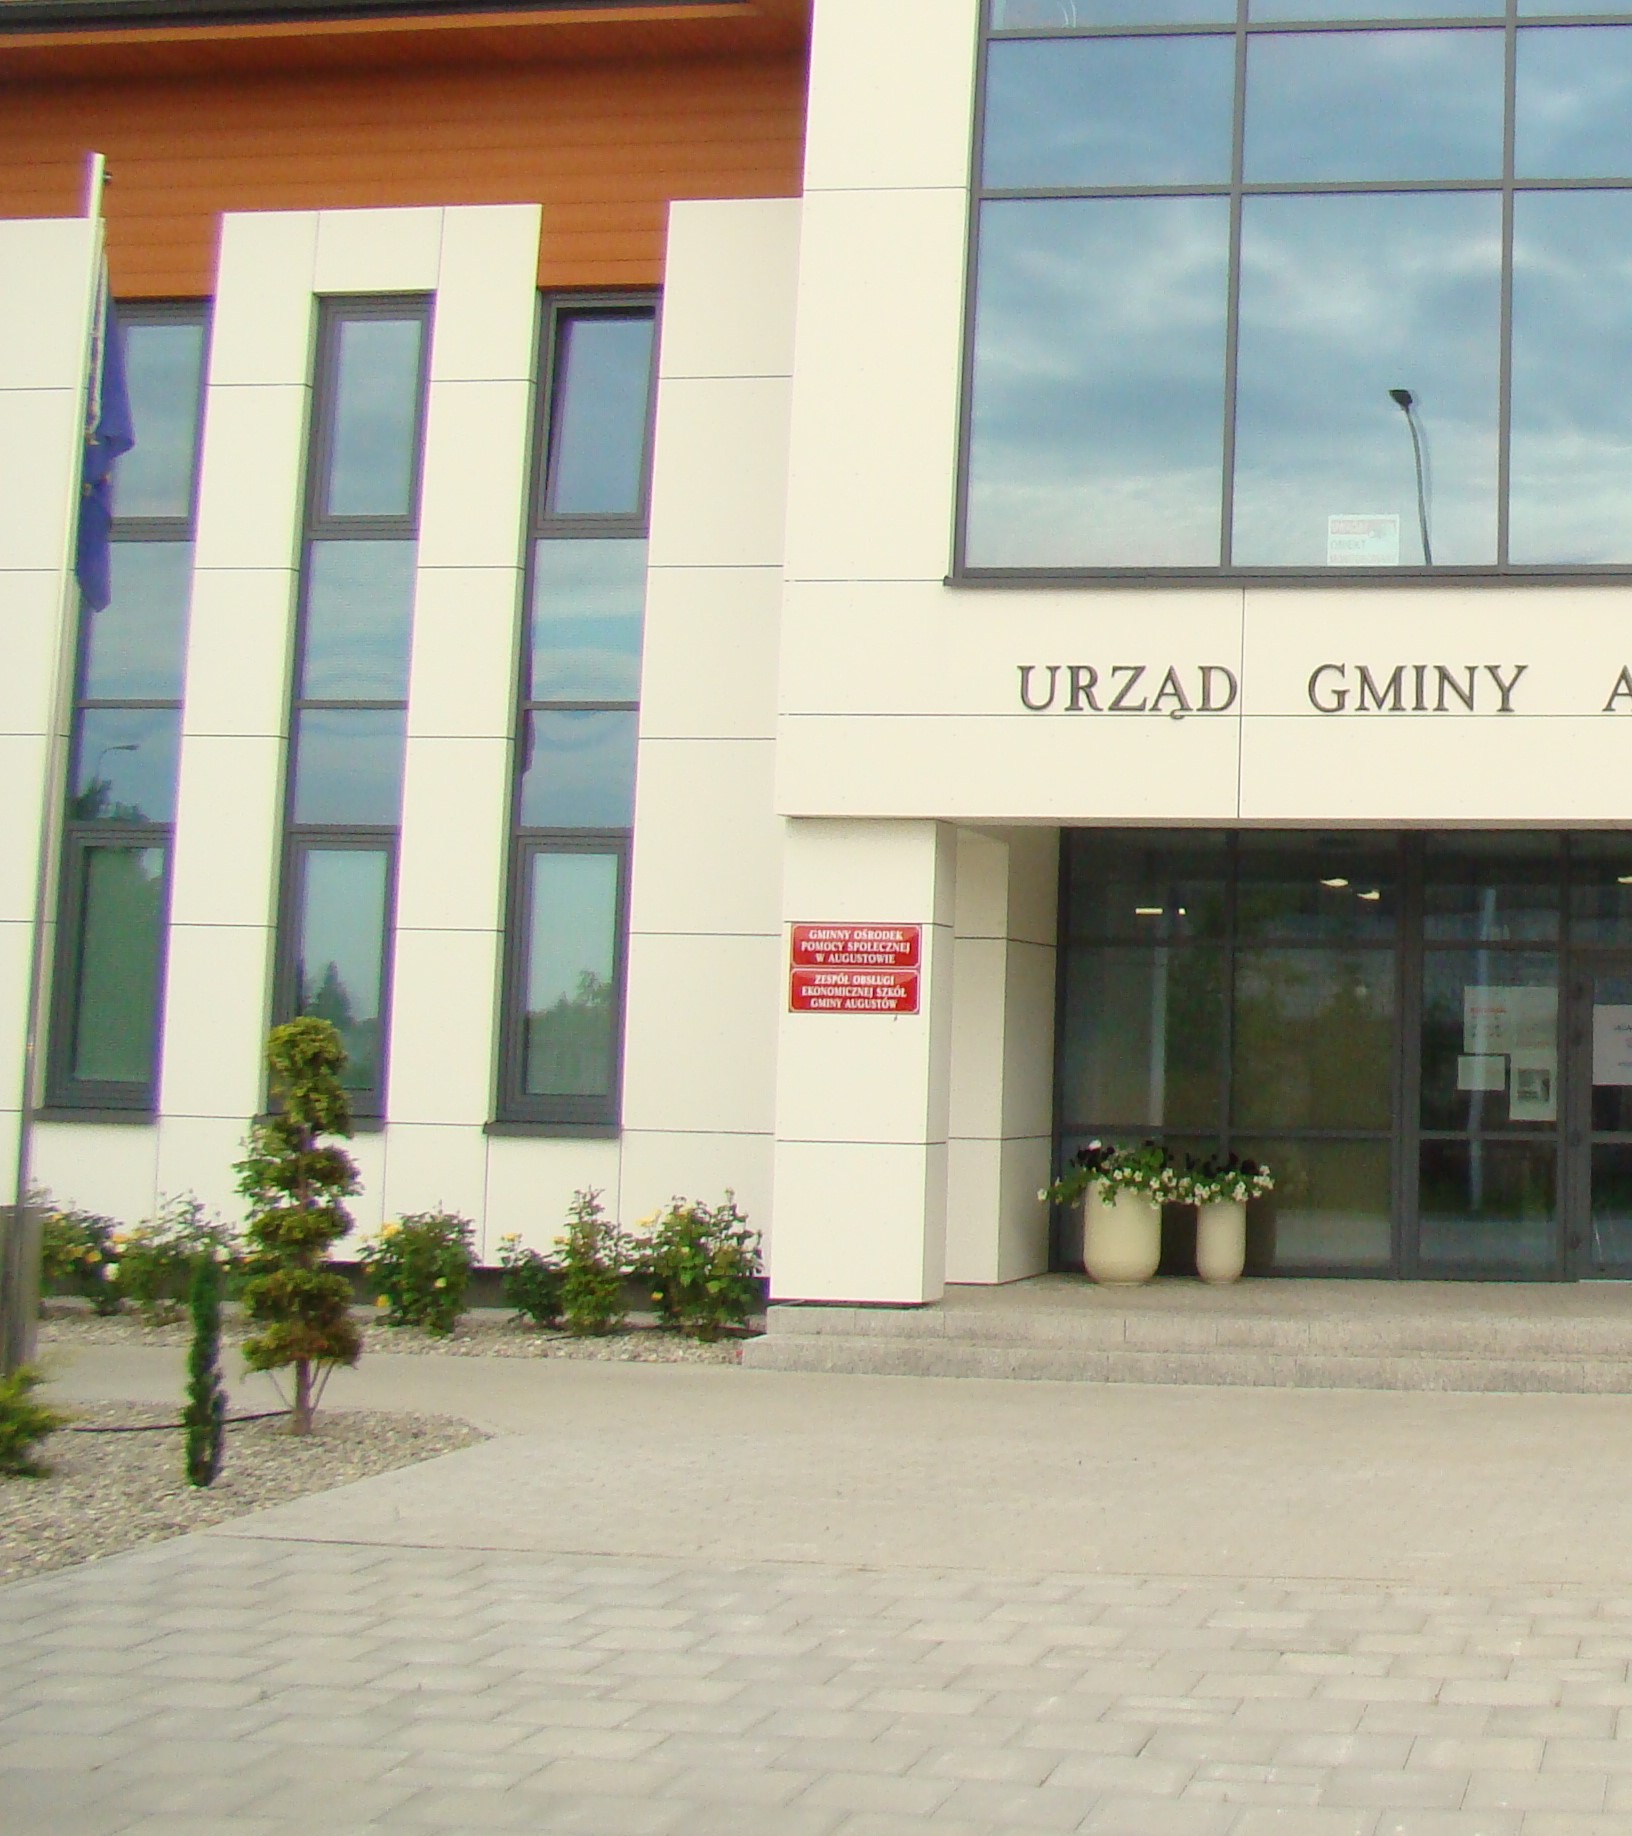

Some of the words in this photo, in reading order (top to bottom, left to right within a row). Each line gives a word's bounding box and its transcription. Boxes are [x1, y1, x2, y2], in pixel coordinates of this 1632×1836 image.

[1017, 664, 1239, 721] URZĄD
[1307, 664, 1528, 713] GMINY
[808, 929, 851, 940] GMINNY
[853, 928, 904, 941] OŚRODEK
[801, 941, 845, 952] POMOCY
[847, 941, 911, 954] SPOŁECZNEJ
[815, 953, 825, 963] W
[828, 953, 896, 964] AUGUSTOWIE
[814, 973, 850, 985] ZESPÓŁ
[852, 975, 895, 985] OBSŁUGI
[801, 985, 874, 998] EKONOMICZNEJ
[876, 985, 907, 998] SZKÓŁ
[810, 998, 843, 1009] GMINY
[845, 996, 898, 1009] AUGUSTÓW
